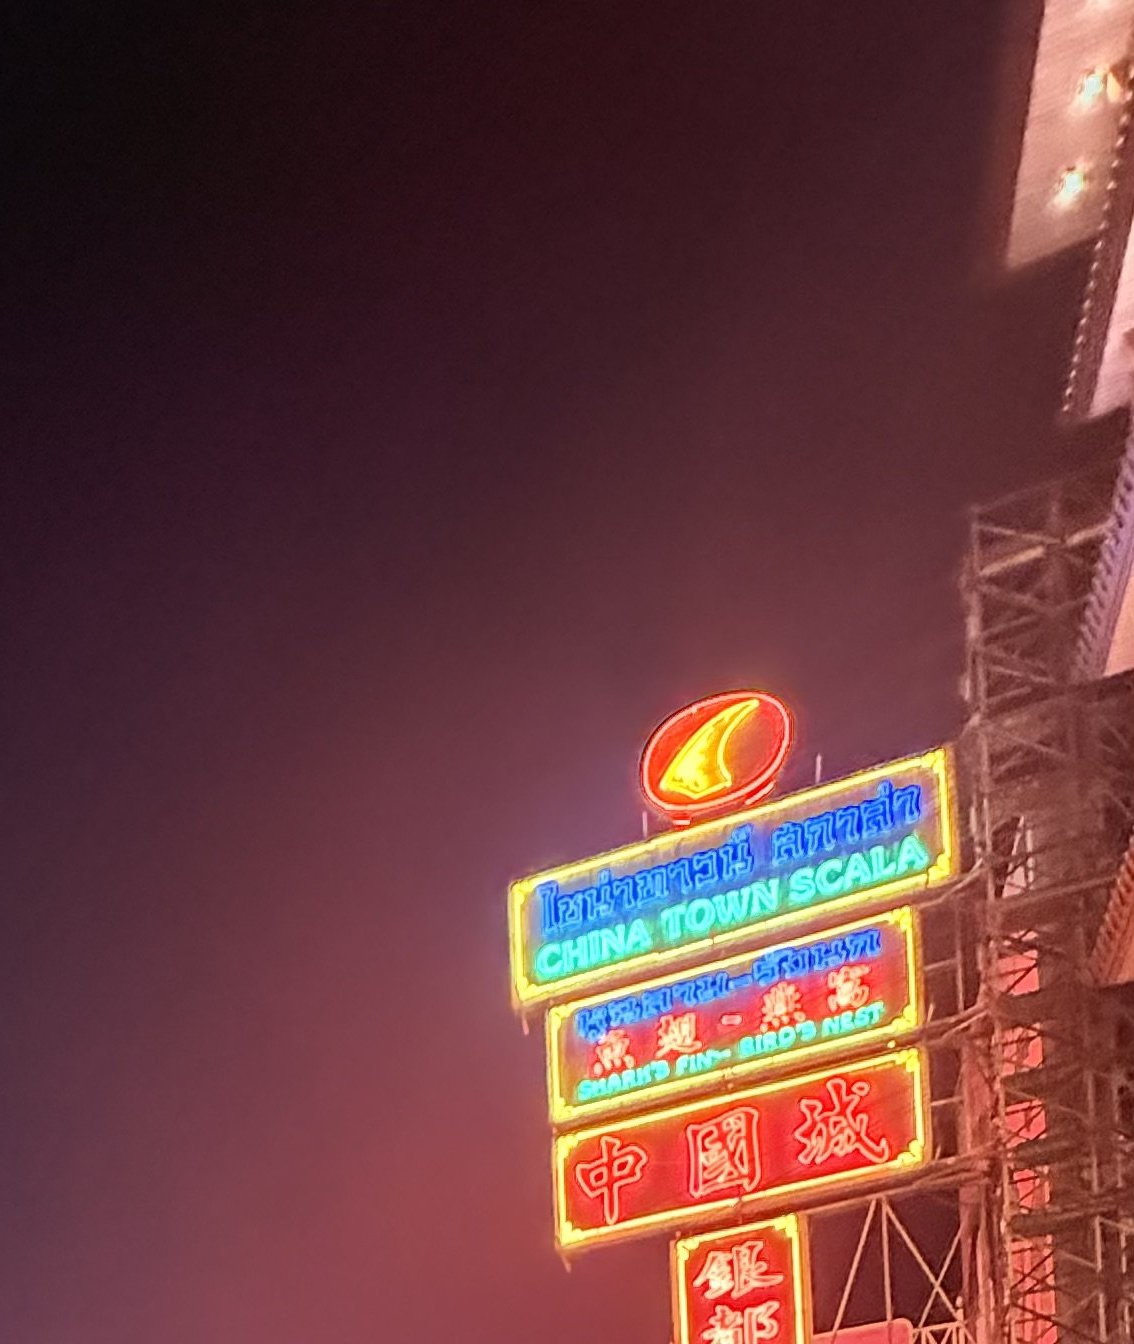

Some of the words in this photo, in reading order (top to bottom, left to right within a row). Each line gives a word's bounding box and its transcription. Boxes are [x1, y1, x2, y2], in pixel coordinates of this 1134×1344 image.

[536, 917, 653, 979] CHINA
[660, 880, 780, 941] TOWN
[788, 833, 930, 898] SCALA
[577, 1057, 670, 1101] SHARK'S
[737, 1016, 817, 1058] BIRD'S
[822, 1001, 886, 1037] NEST
[575, 1077, 890, 1226] 中國城
